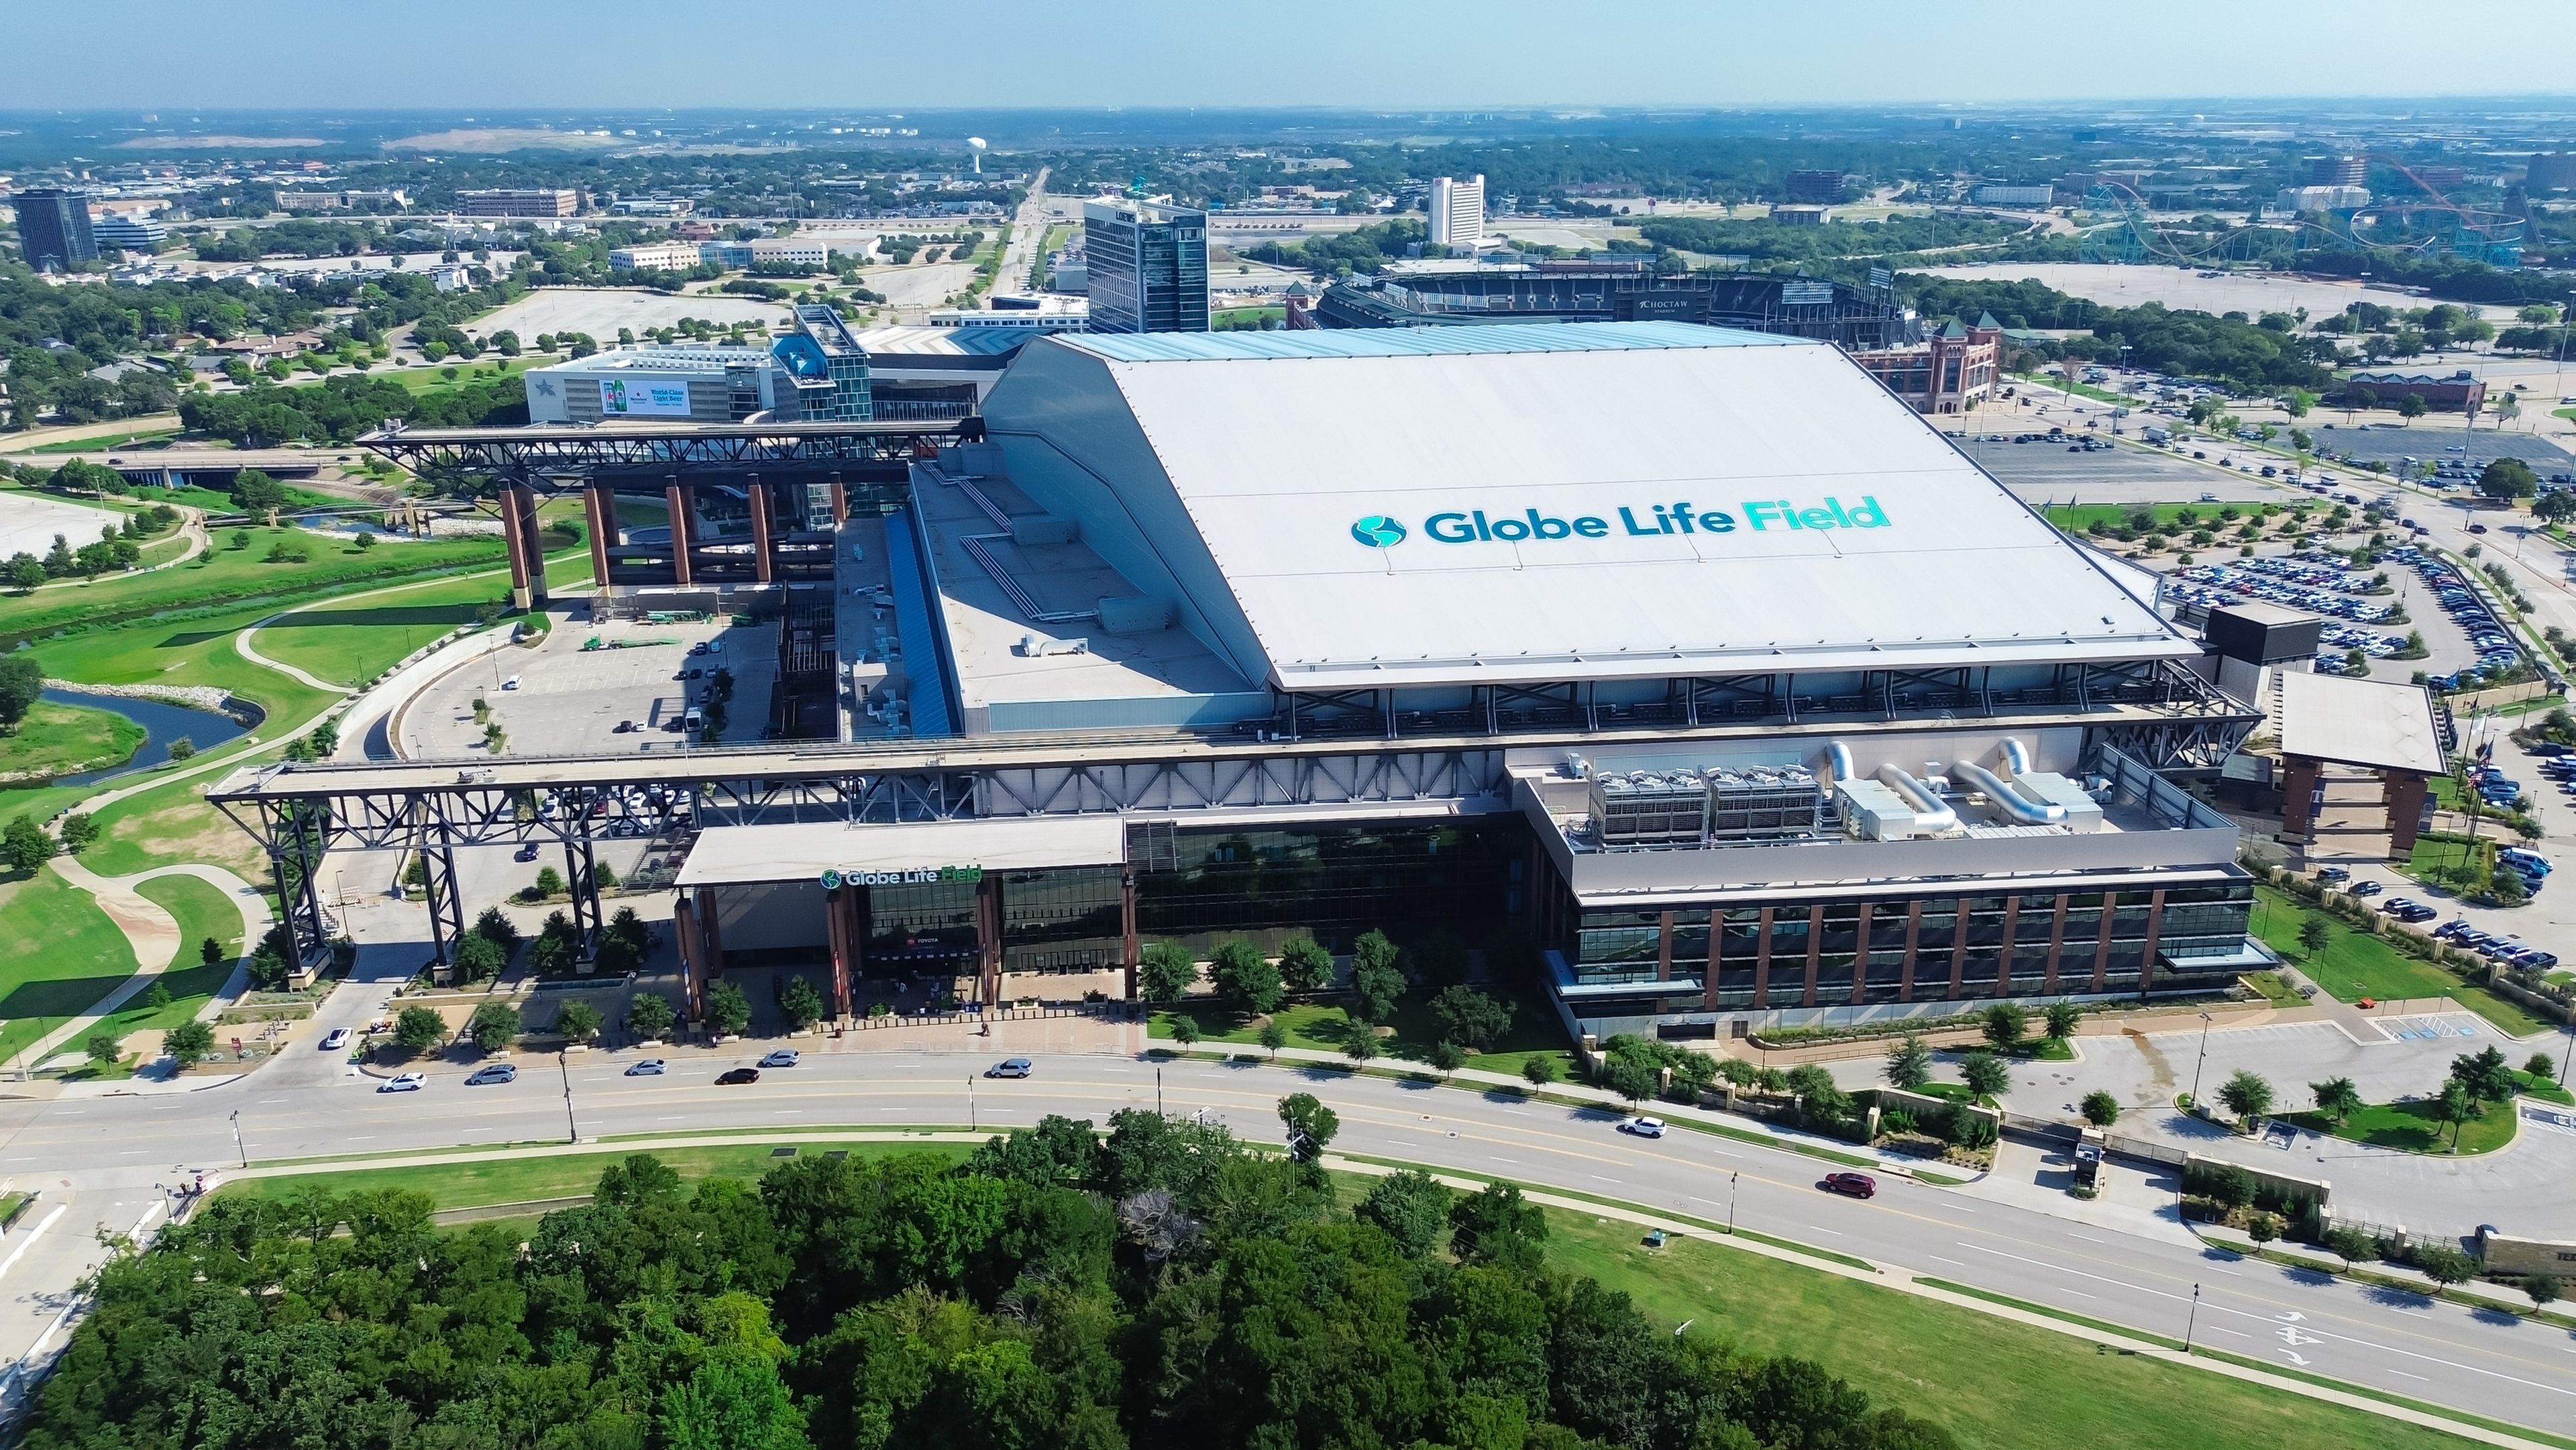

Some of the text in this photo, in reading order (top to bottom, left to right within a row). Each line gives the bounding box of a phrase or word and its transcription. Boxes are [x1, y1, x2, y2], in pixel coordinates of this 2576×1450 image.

[1116, 211, 1135, 223] LOEWS
[1640, 301, 1688, 309] CHOCTAW
[1424, 496, 1892, 543] Globe Life Field
[846, 864, 983, 886] Globe Life Field
